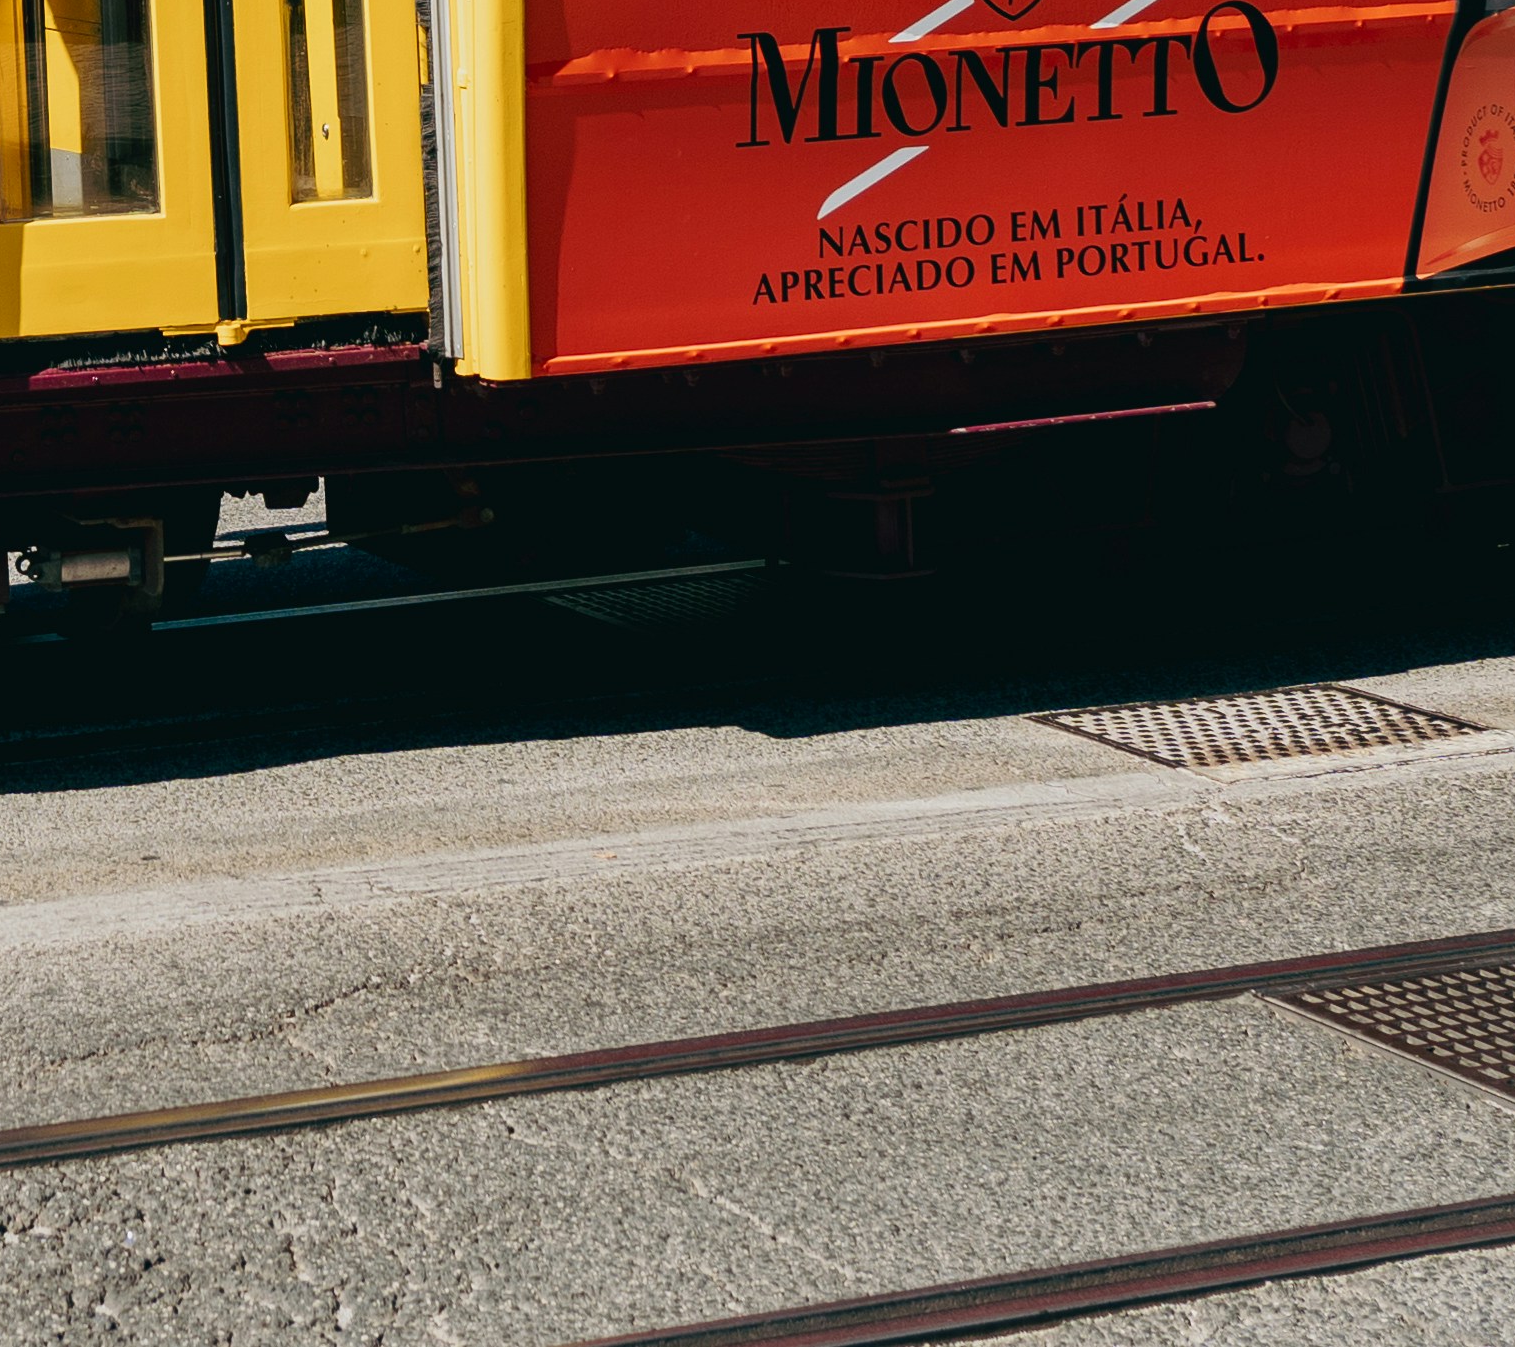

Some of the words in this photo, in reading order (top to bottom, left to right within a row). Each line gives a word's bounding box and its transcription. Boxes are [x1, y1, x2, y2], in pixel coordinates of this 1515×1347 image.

[1461, 105, 1487, 167] PRODUCT
[1490, 104, 1504, 117] OF
[817, 213, 995, 259] NASCIDO
[1010, 208, 1062, 244] EM
[1076, 193, 1204, 238] ITÁLIA,
[752, 256, 975, 306] APRECIADO
[990, 250, 1042, 285] EM
[1056, 232, 1266, 279] PORTUGAL.
